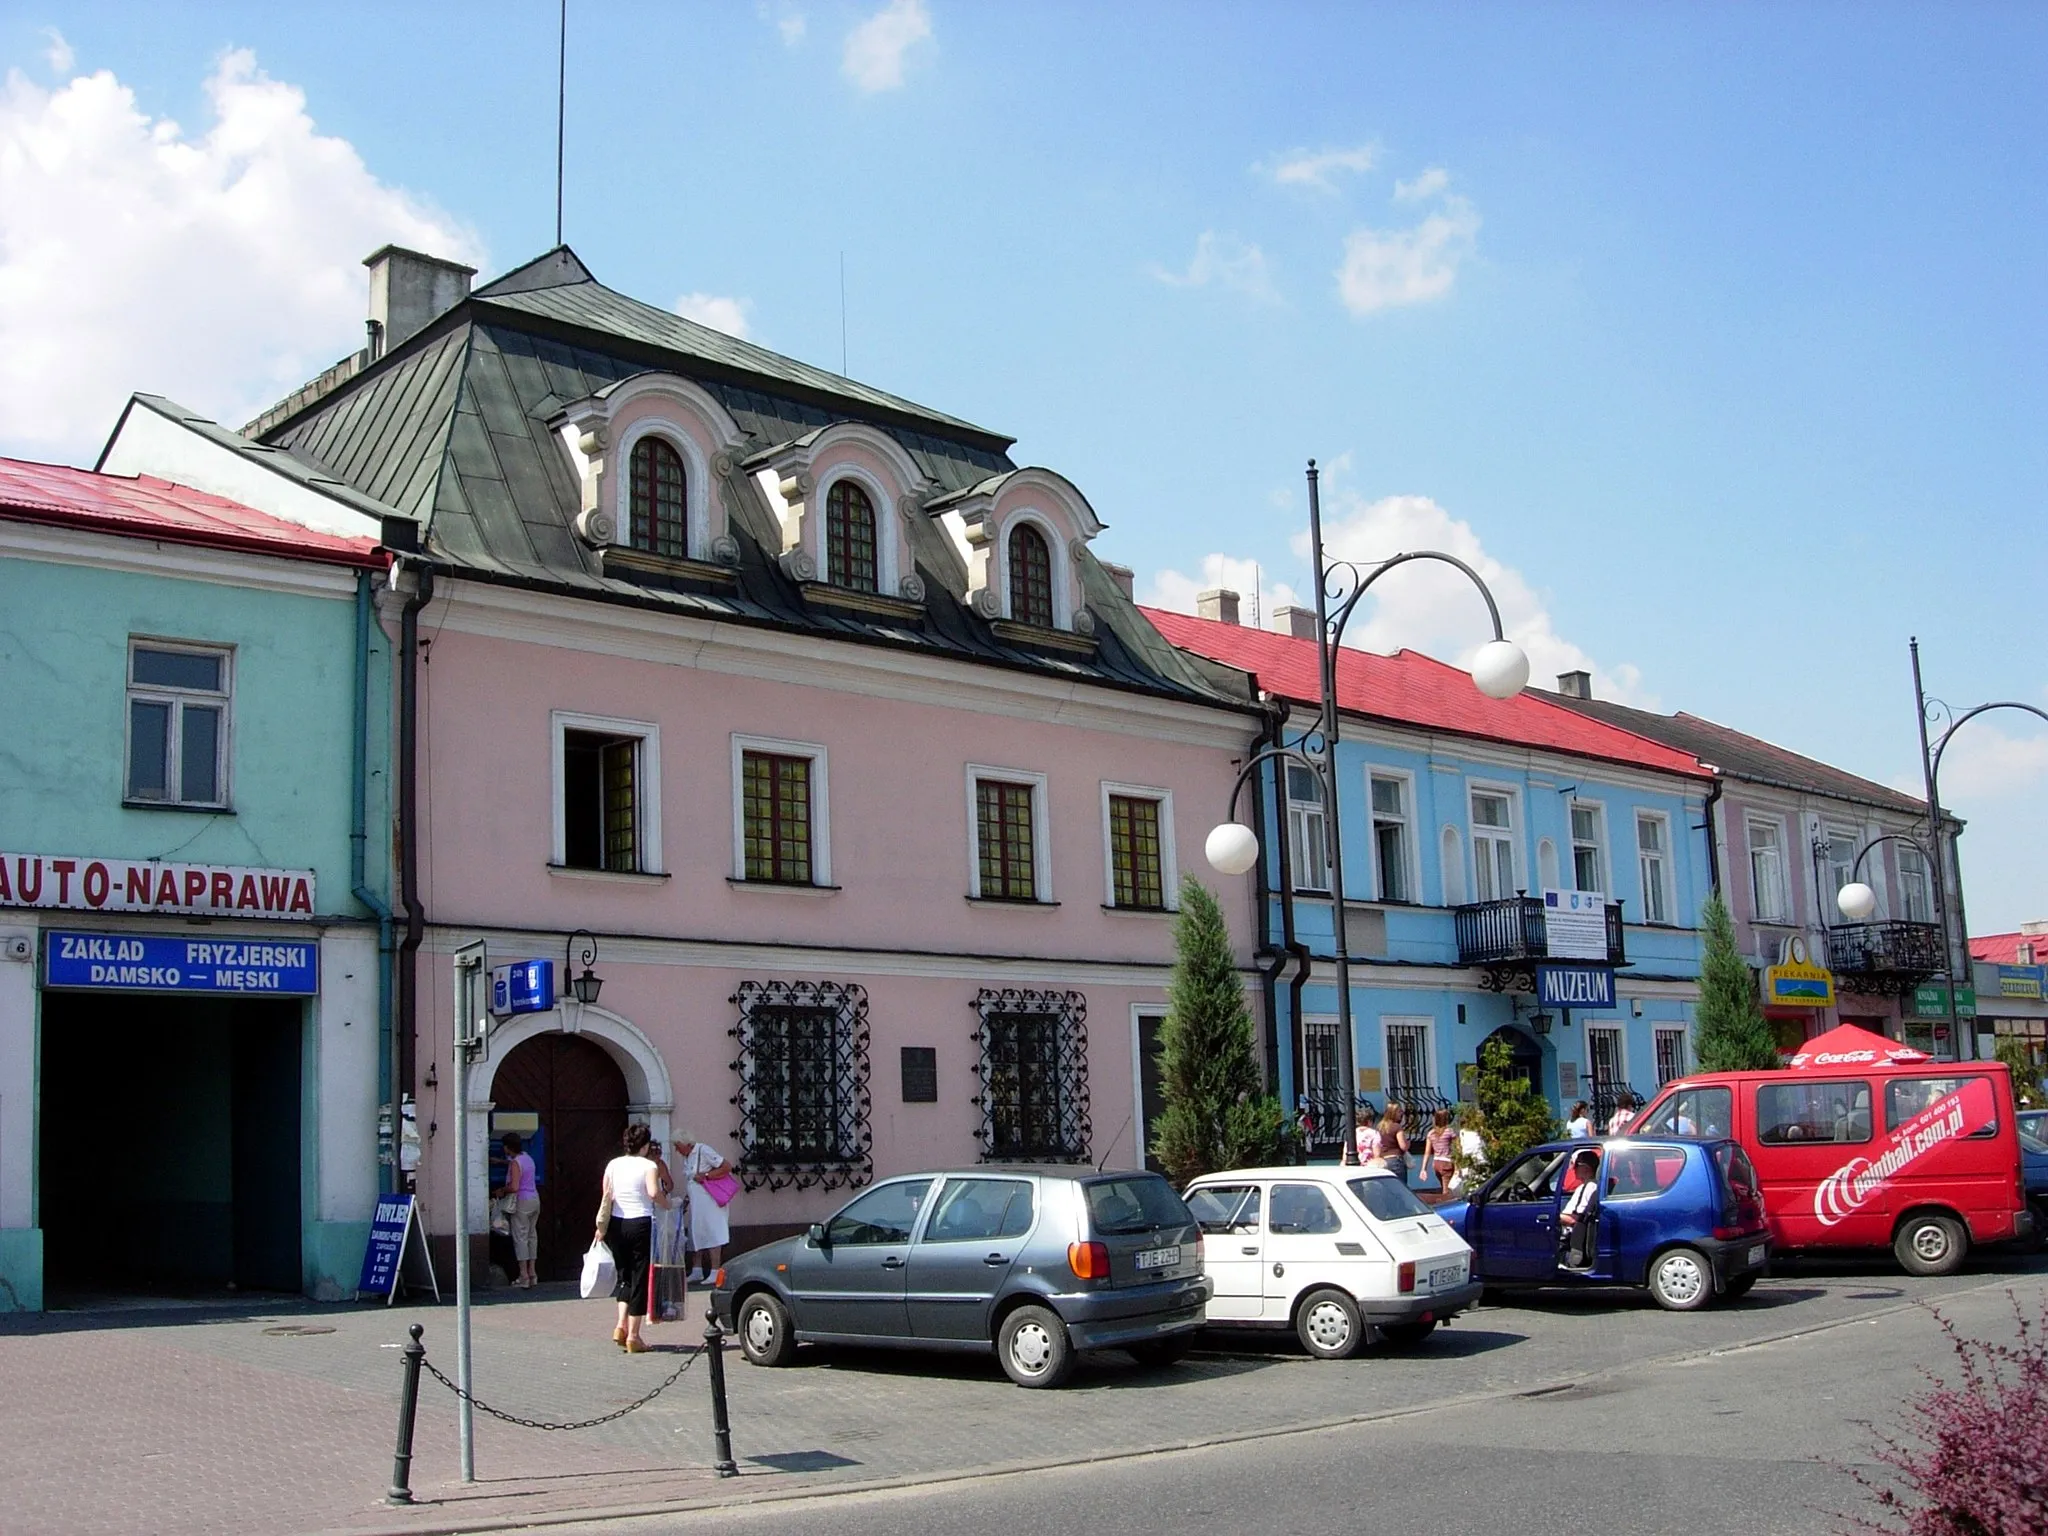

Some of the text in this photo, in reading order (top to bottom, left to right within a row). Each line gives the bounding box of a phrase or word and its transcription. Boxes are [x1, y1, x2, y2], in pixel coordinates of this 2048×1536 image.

[16, 942, 26, 953] 6
[61, 937, 306, 968] ZAKŁAD FRYZJERSKI
[91, 965, 180, 985] DAMSKO
[216, 970, 279, 990] MĘSKI
[1772, 969, 1828, 981] PIEKARNIA
[1544, 970, 1609, 1003] MUZEUM
[1814, 1050, 1876, 1065] Coca-Cola
[1919, 1112, 1932, 1125] 601
[1933, 1103, 1946, 1116] 400
[1853, 1103, 1964, 1202] paintball.com.pl
[375, 1204, 409, 1223] FRYZJER
